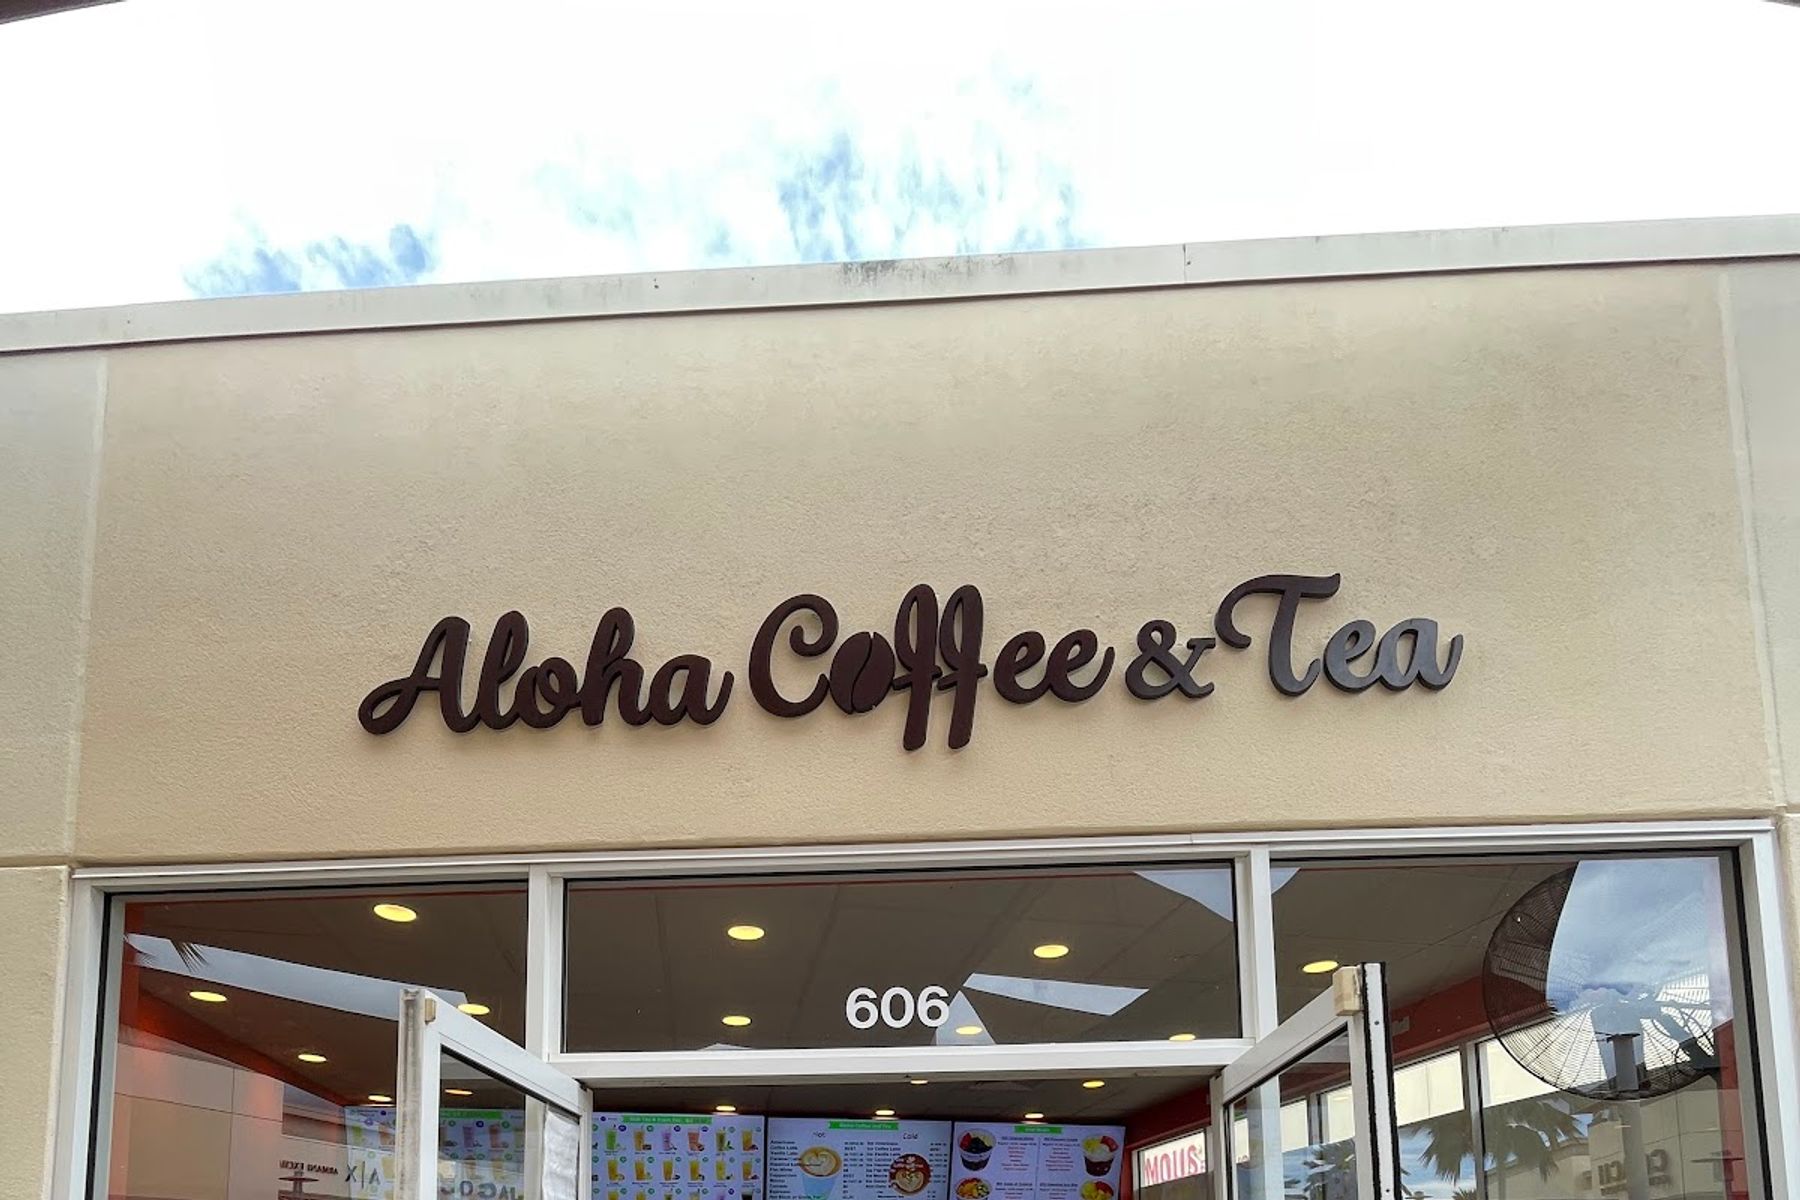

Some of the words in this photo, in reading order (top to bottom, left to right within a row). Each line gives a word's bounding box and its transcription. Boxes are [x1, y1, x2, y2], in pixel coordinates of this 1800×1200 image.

[358, 607, 735, 735] Aloha
[748, 584, 1115, 752] Coffee
[1125, 619, 1216, 700] &
[1215, 573, 1463, 697] Tea
[845, 985, 950, 1029] 606
